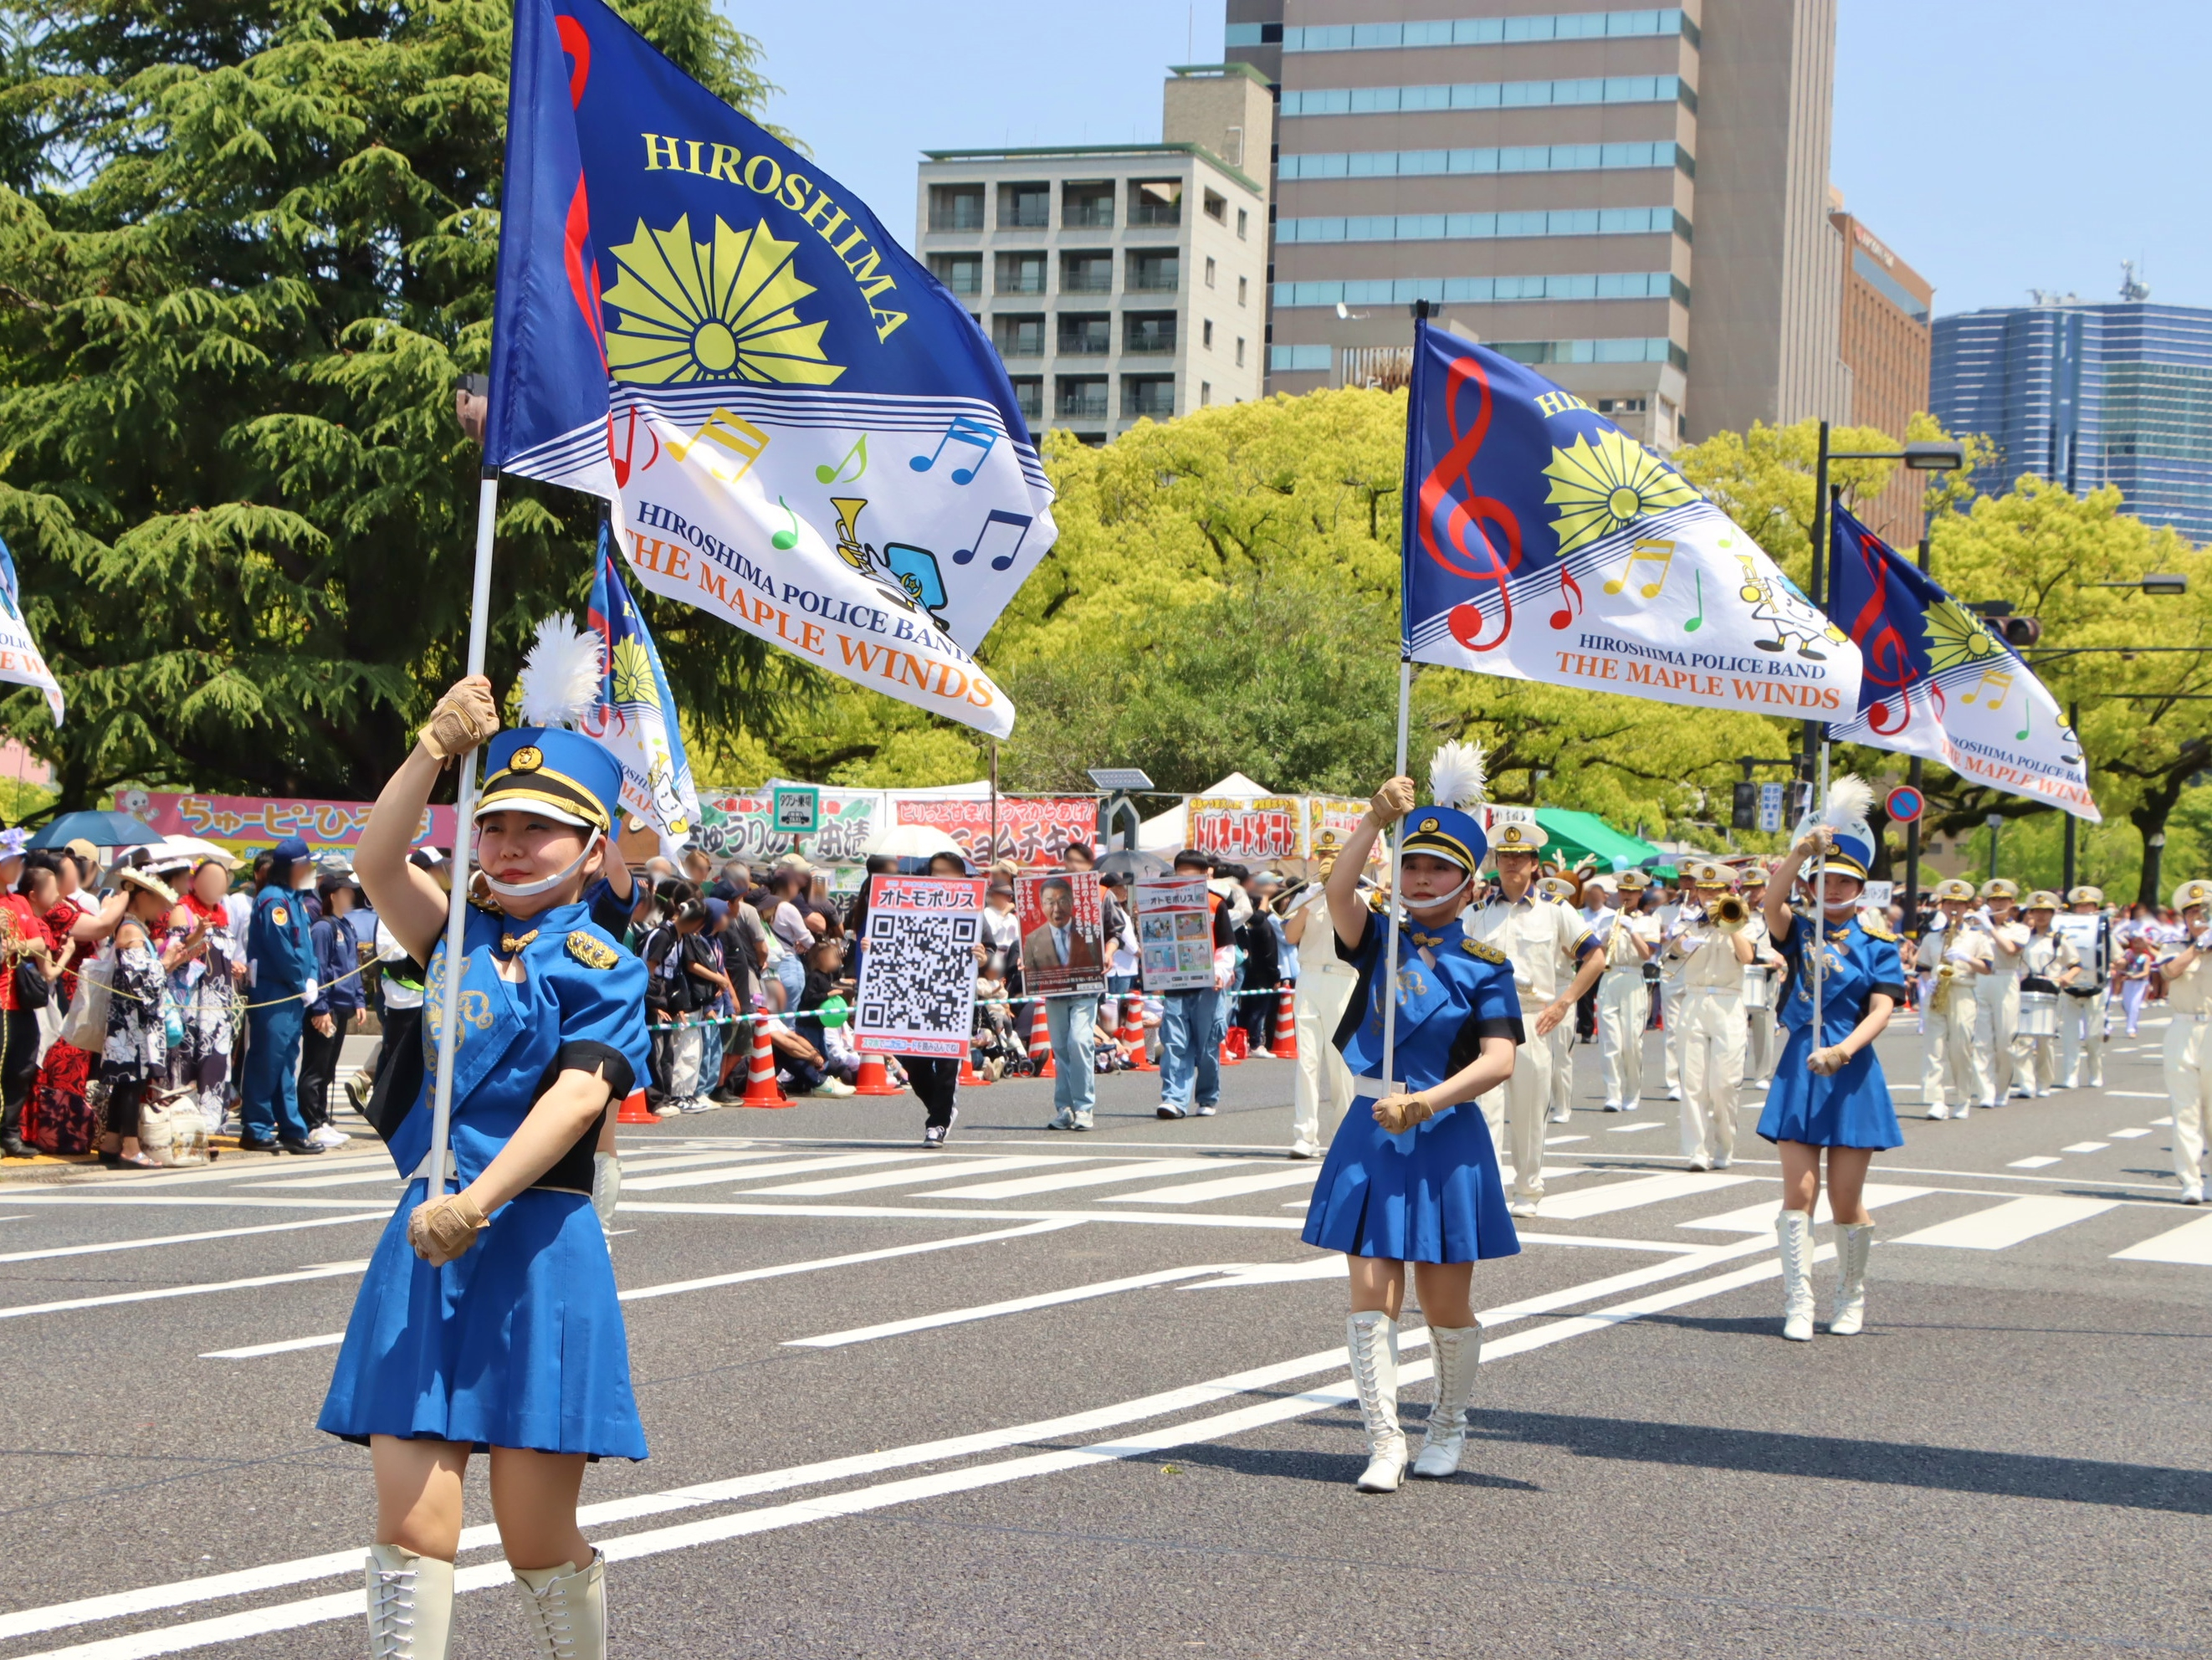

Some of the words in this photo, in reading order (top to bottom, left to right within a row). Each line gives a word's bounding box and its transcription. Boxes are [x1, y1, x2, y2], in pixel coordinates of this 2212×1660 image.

[641, 133, 909, 345] HIROSHIMA
[637, 500, 777, 598] HIROSHIMA
[781, 583, 888, 633] POLICE
[892, 617, 972, 664] BAND
[697, 561, 826, 657] MAPLE
[836, 633, 995, 709] WINDS
[1580, 633, 1686, 666] HIROSHIMA
[1691, 653, 1763, 674] POLICE
[1767, 661, 1826, 679] BAND
[1556, 651, 1619, 679] THE
[1625, 661, 1724, 696] MAPLE
[1731, 678, 1841, 710] WINDS
[1964, 756, 2034, 789] MAPLE
[2036, 778, 2094, 807] WIND
[2016, 756, 2064, 778] POLICE
[2066, 770, 2084, 784] BA
[1194, 812, 1295, 856] トルネードポテト
[879, 889, 975, 908] オトモポリス
[1150, 894, 1194, 905] オトモポリス
